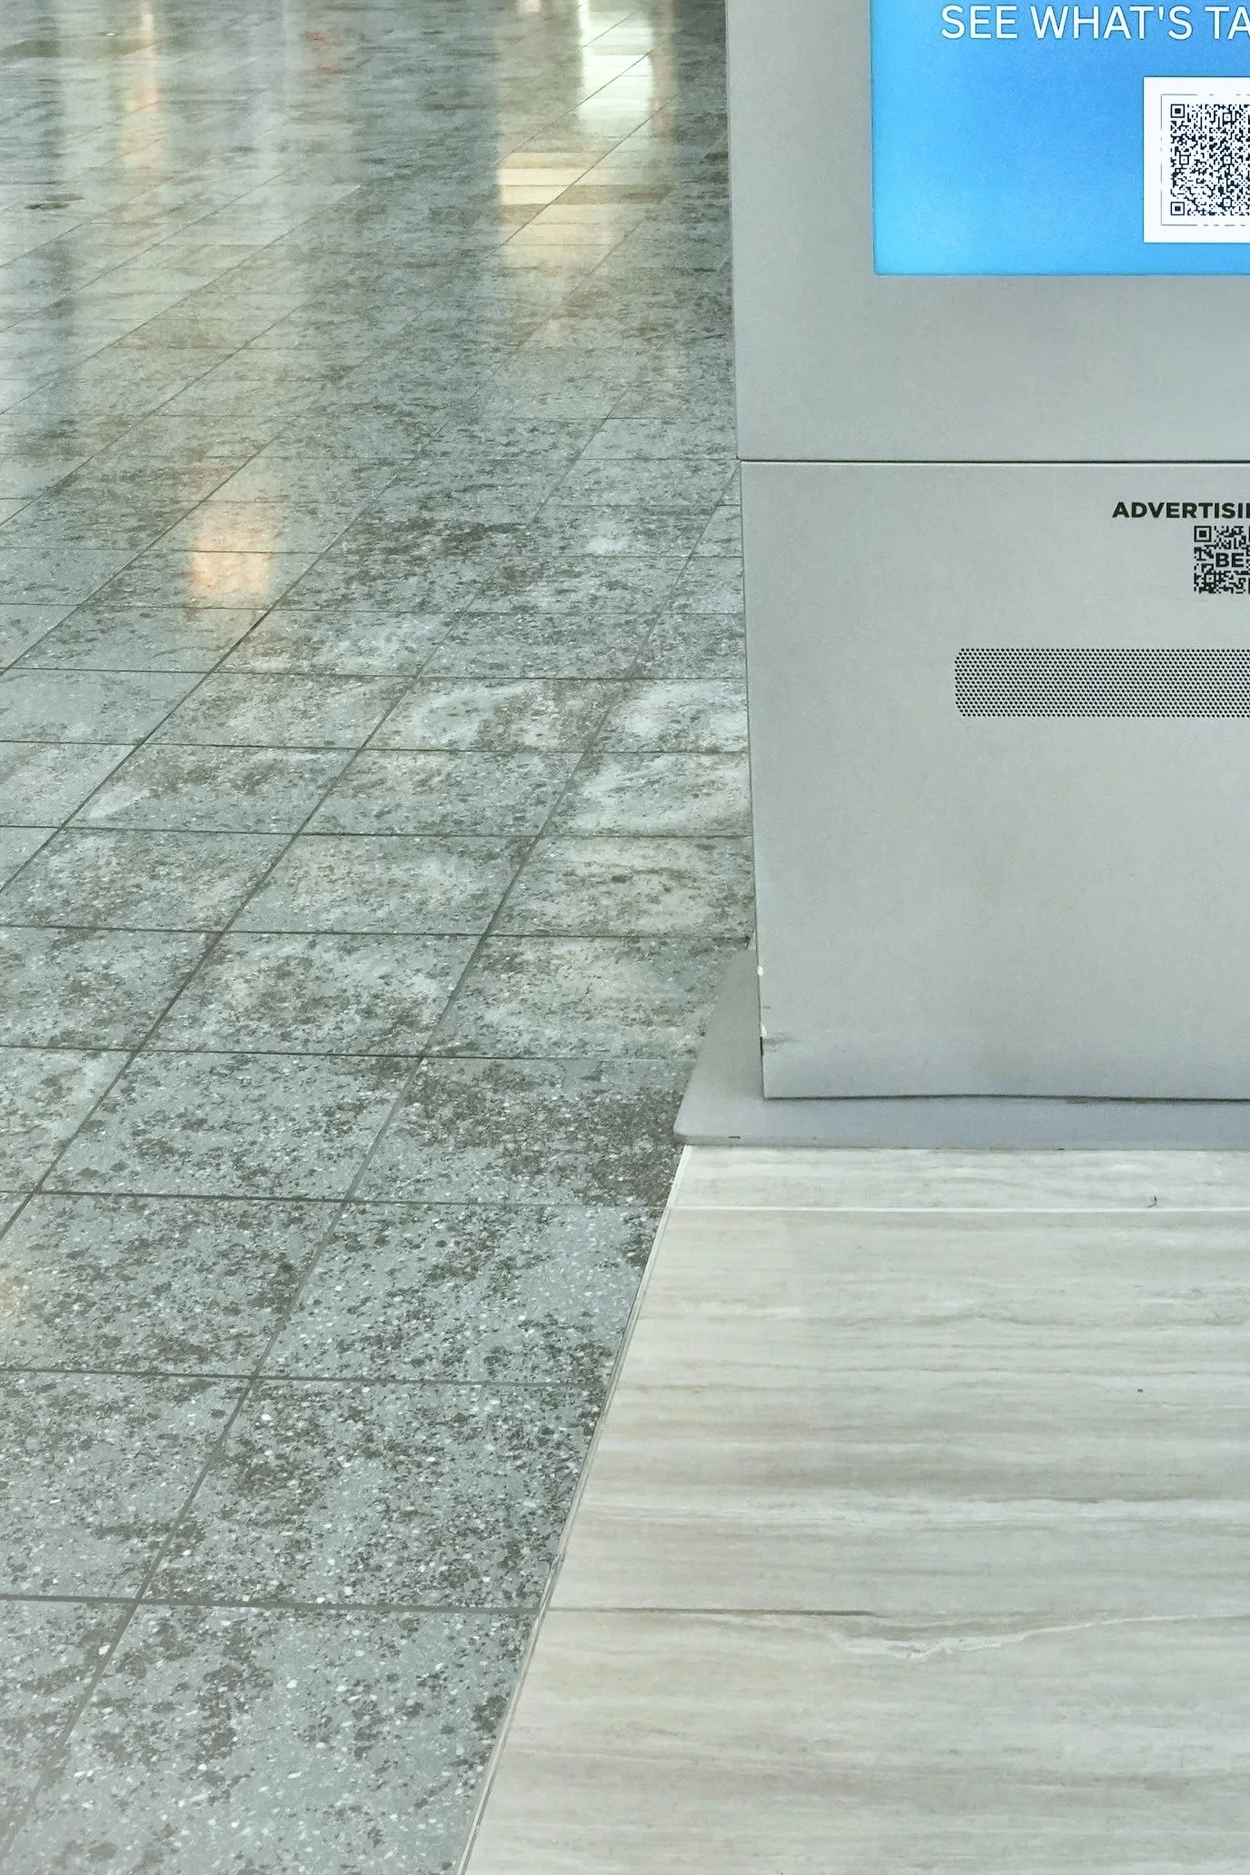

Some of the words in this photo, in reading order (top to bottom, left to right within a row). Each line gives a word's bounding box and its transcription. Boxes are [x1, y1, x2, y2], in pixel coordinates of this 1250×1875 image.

[940, 4, 1018, 40] SEE
[1030, 5, 1193, 41] WHAT'S
[1214, 551, 1246, 569] BE
